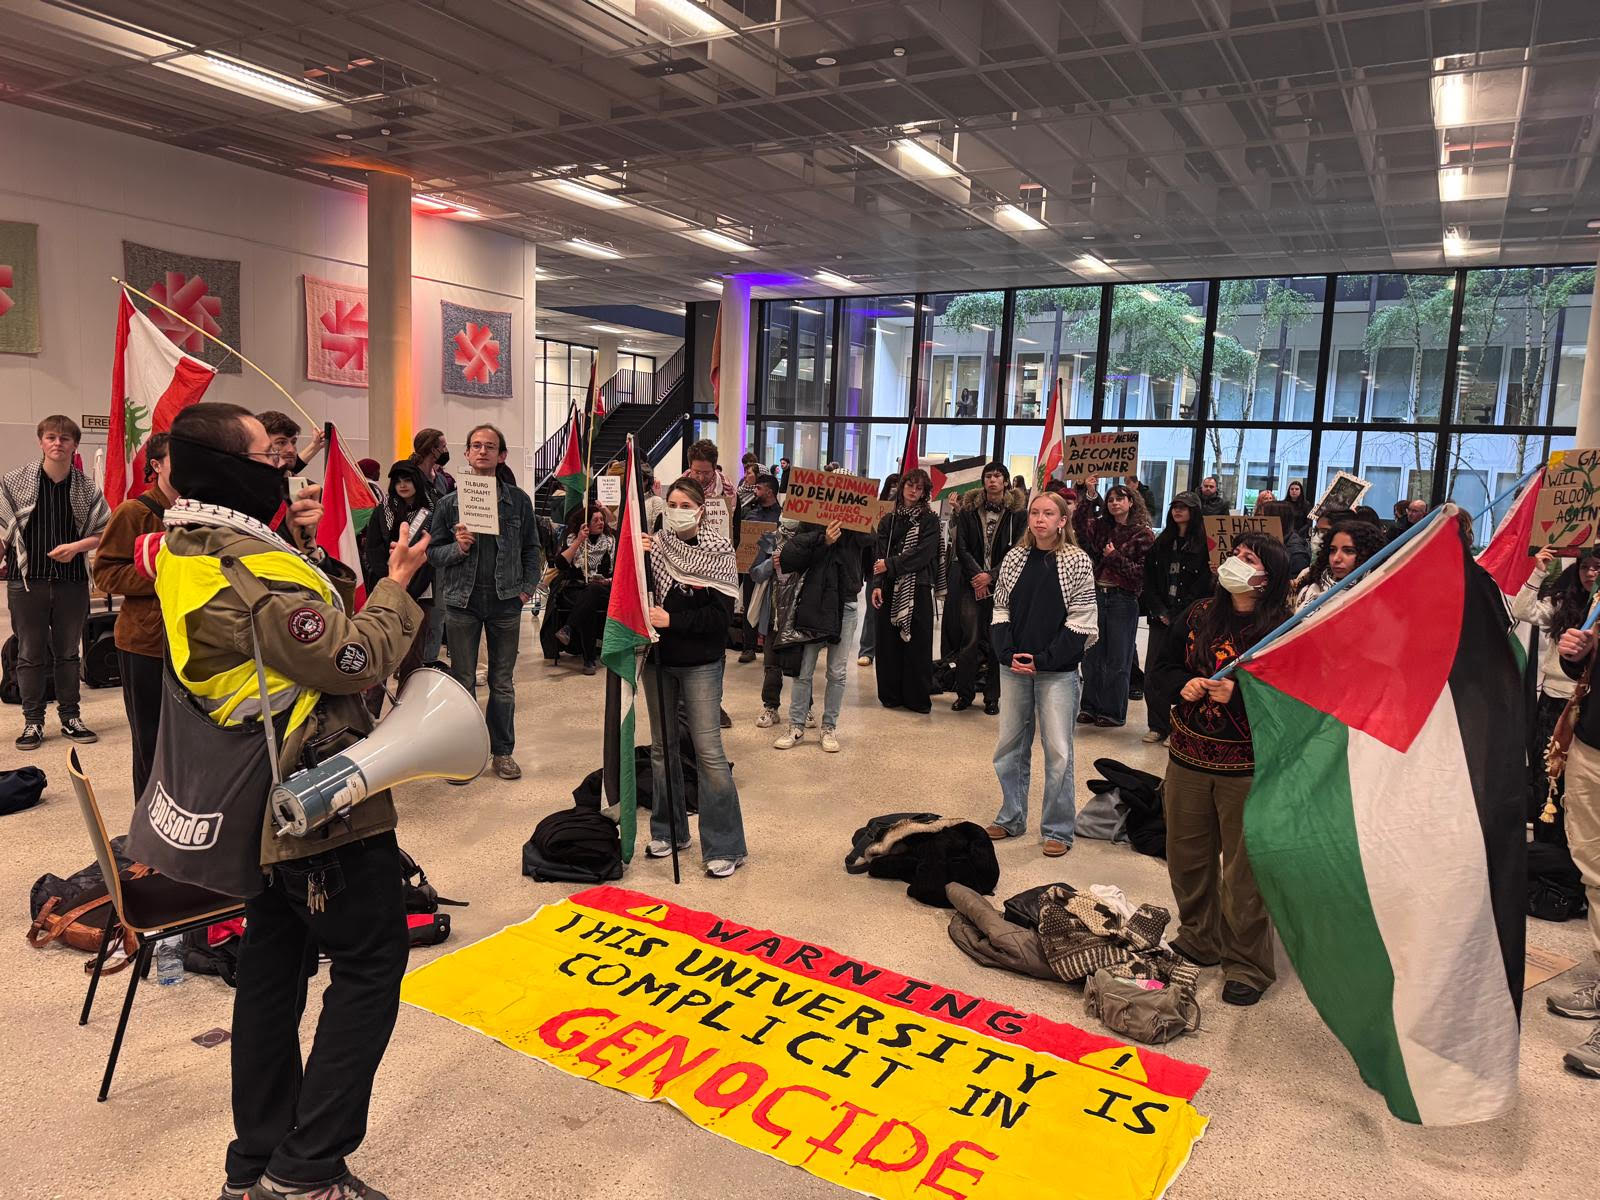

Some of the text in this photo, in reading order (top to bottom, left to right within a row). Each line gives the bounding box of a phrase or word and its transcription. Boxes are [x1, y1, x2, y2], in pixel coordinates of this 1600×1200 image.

[88, 417, 111, 427] FRE
[1070, 437, 1077, 448] A
[1080, 434, 1115, 445] THIEF
[1069, 446, 1136, 461] BECOMES
[1066, 461, 1129, 475] AN OWNER
[794, 469, 823, 486] WAR
[1548, 471, 1577, 488] WILL
[789, 483, 869, 507] TO DEN HAAG
[1553, 488, 1594, 506] BLOOM
[785, 499, 813, 514] NOT
[819, 501, 861, 515] TILBURG
[1556, 505, 1598, 524] AGAIN
[816, 511, 873, 526] UNIVERSITY
[1216, 518, 1269, 534] I HATE
[151, 792, 210, 845] episode
[706, 920, 1029, 1036] WARNING
[554, 910, 1171, 1135] THIS UNIVERSITY IS
[558, 952, 1031, 1129] COMPLICIT IN
[537, 1006, 999, 1200] GENOCIDE
